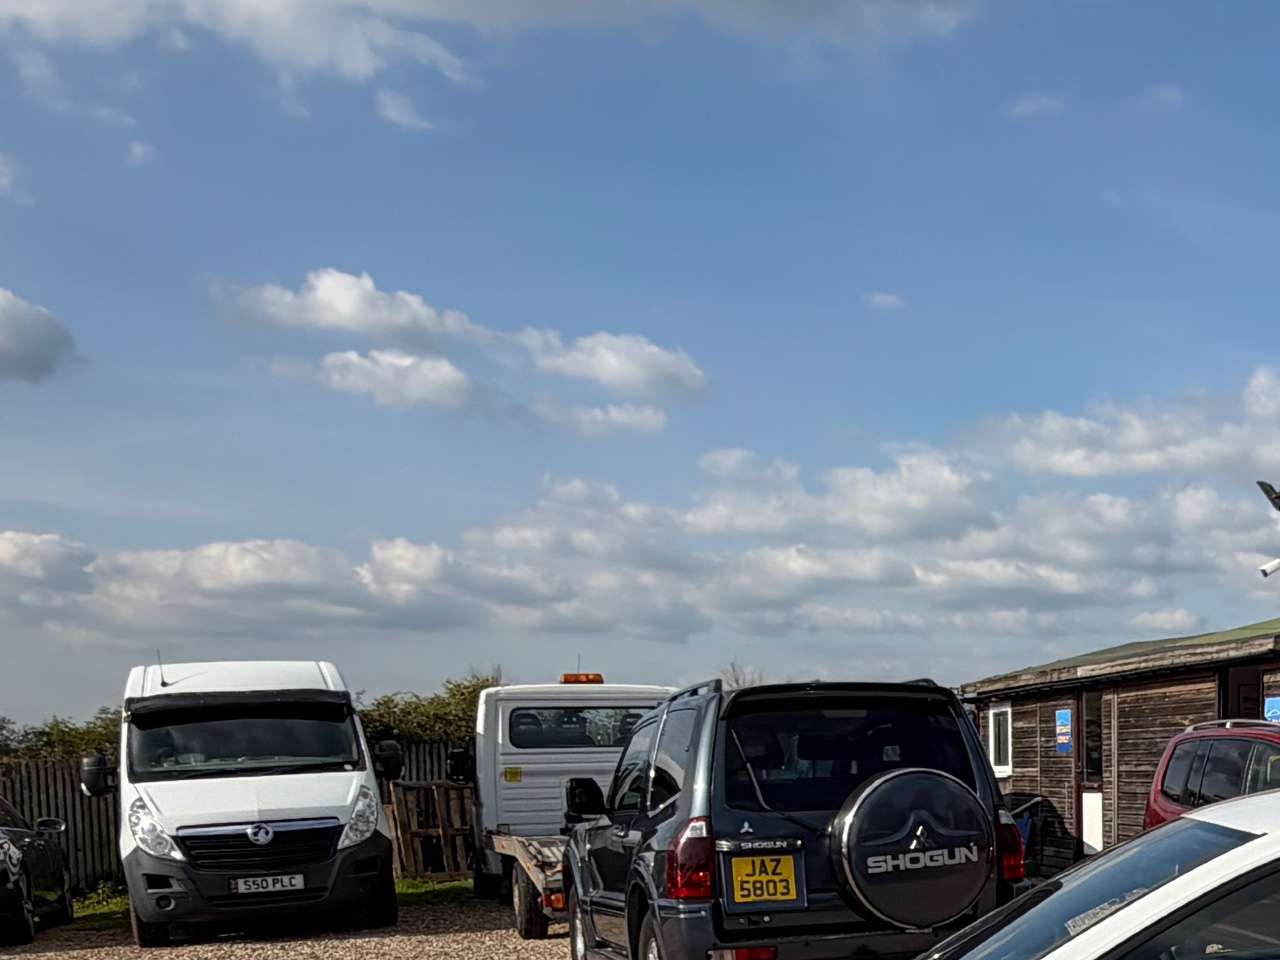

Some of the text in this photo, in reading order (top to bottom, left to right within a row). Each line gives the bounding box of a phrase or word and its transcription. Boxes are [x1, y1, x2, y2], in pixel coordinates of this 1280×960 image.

[740, 841, 787, 849] SHOGUN
[745, 857, 783, 877] JAZ
[867, 843, 979, 874] SHOGUN
[272, 876, 297, 888] PLC
[740, 878, 791, 898] 5803
